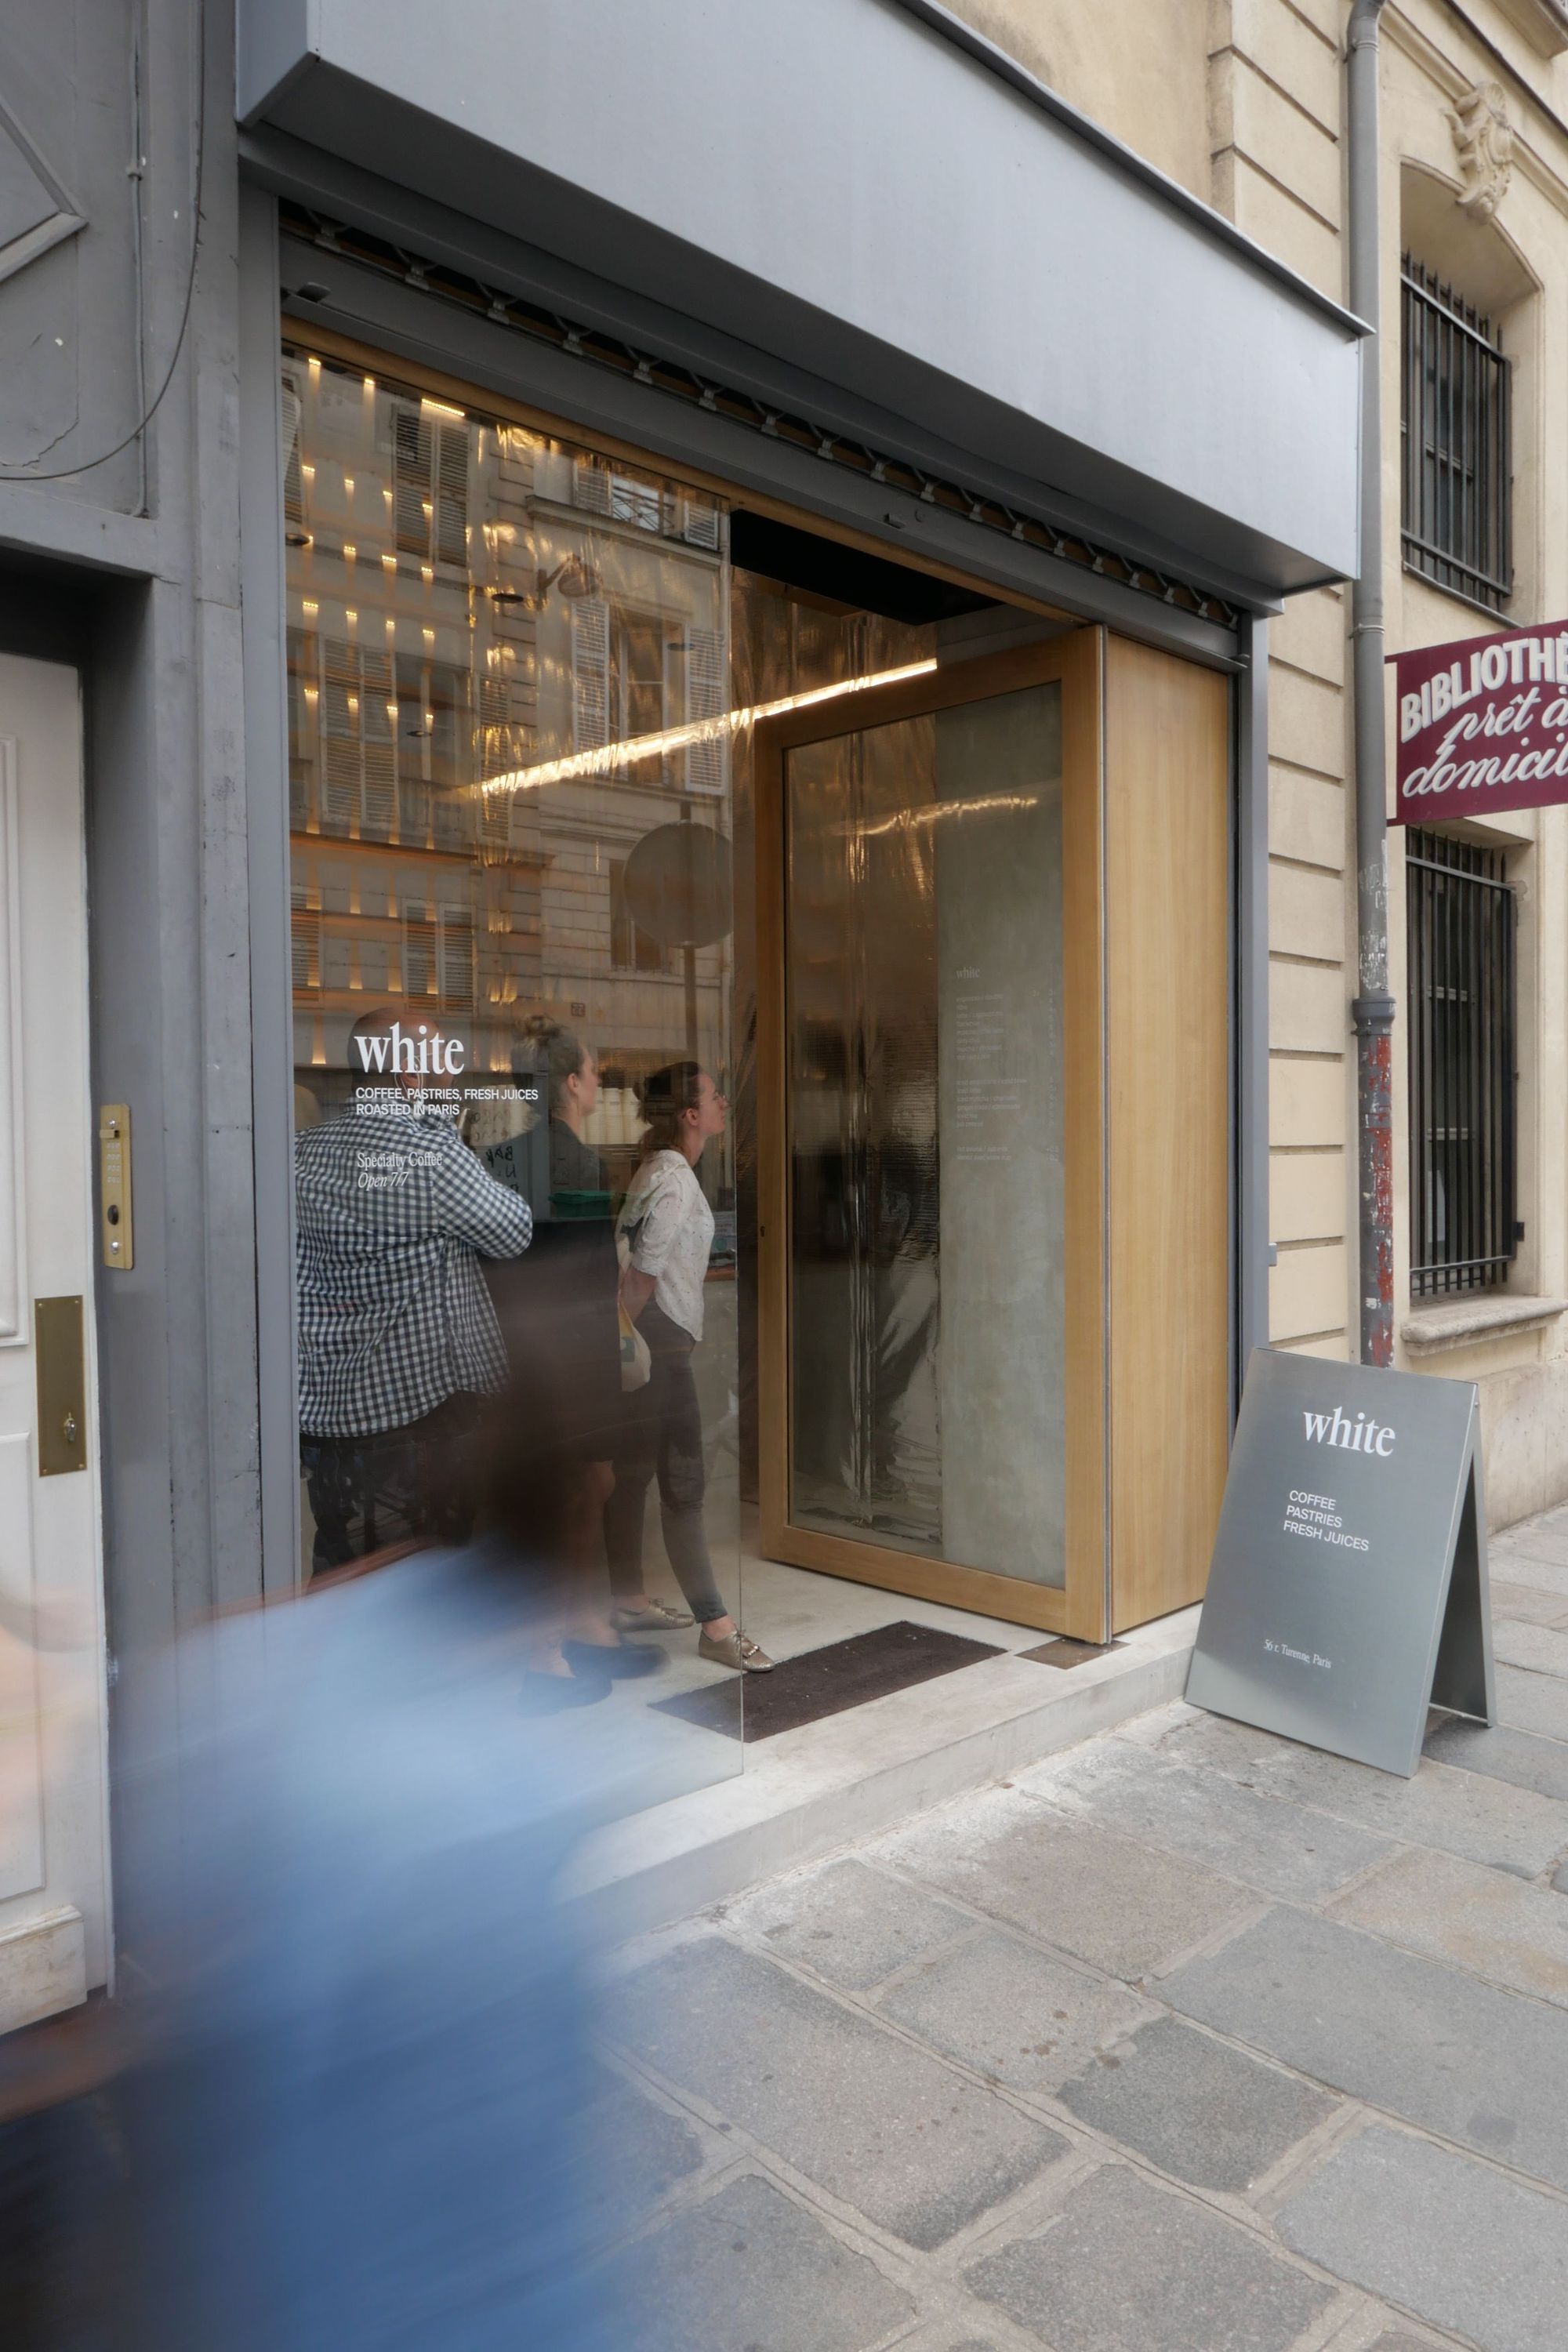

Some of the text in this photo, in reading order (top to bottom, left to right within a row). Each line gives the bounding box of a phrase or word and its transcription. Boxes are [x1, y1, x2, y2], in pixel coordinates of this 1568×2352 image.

[1436, 687, 1541, 755] prêt
[956, 966, 980, 979] white
[354, 1022, 464, 1075] white
[355, 1087, 539, 1102] COFFEE, PASTRIES, FRESH JUICES
[356, 1104, 459, 1116] ROASTED IN PARIS
[357, 1152, 442, 1171] Specialty Coffee
[358, 1172, 408, 1191] Open 7/7
[1304, 1406, 1396, 1457] white
[1289, 1490, 1336, 1511] COFFEE
[1286, 1504, 1342, 1528] PASTRIES
[1283, 1519, 1369, 1551] FRESH JUICES
[1264, 1639, 1273, 1651] 56
[1312, 1653, 1332, 1669] Paris
